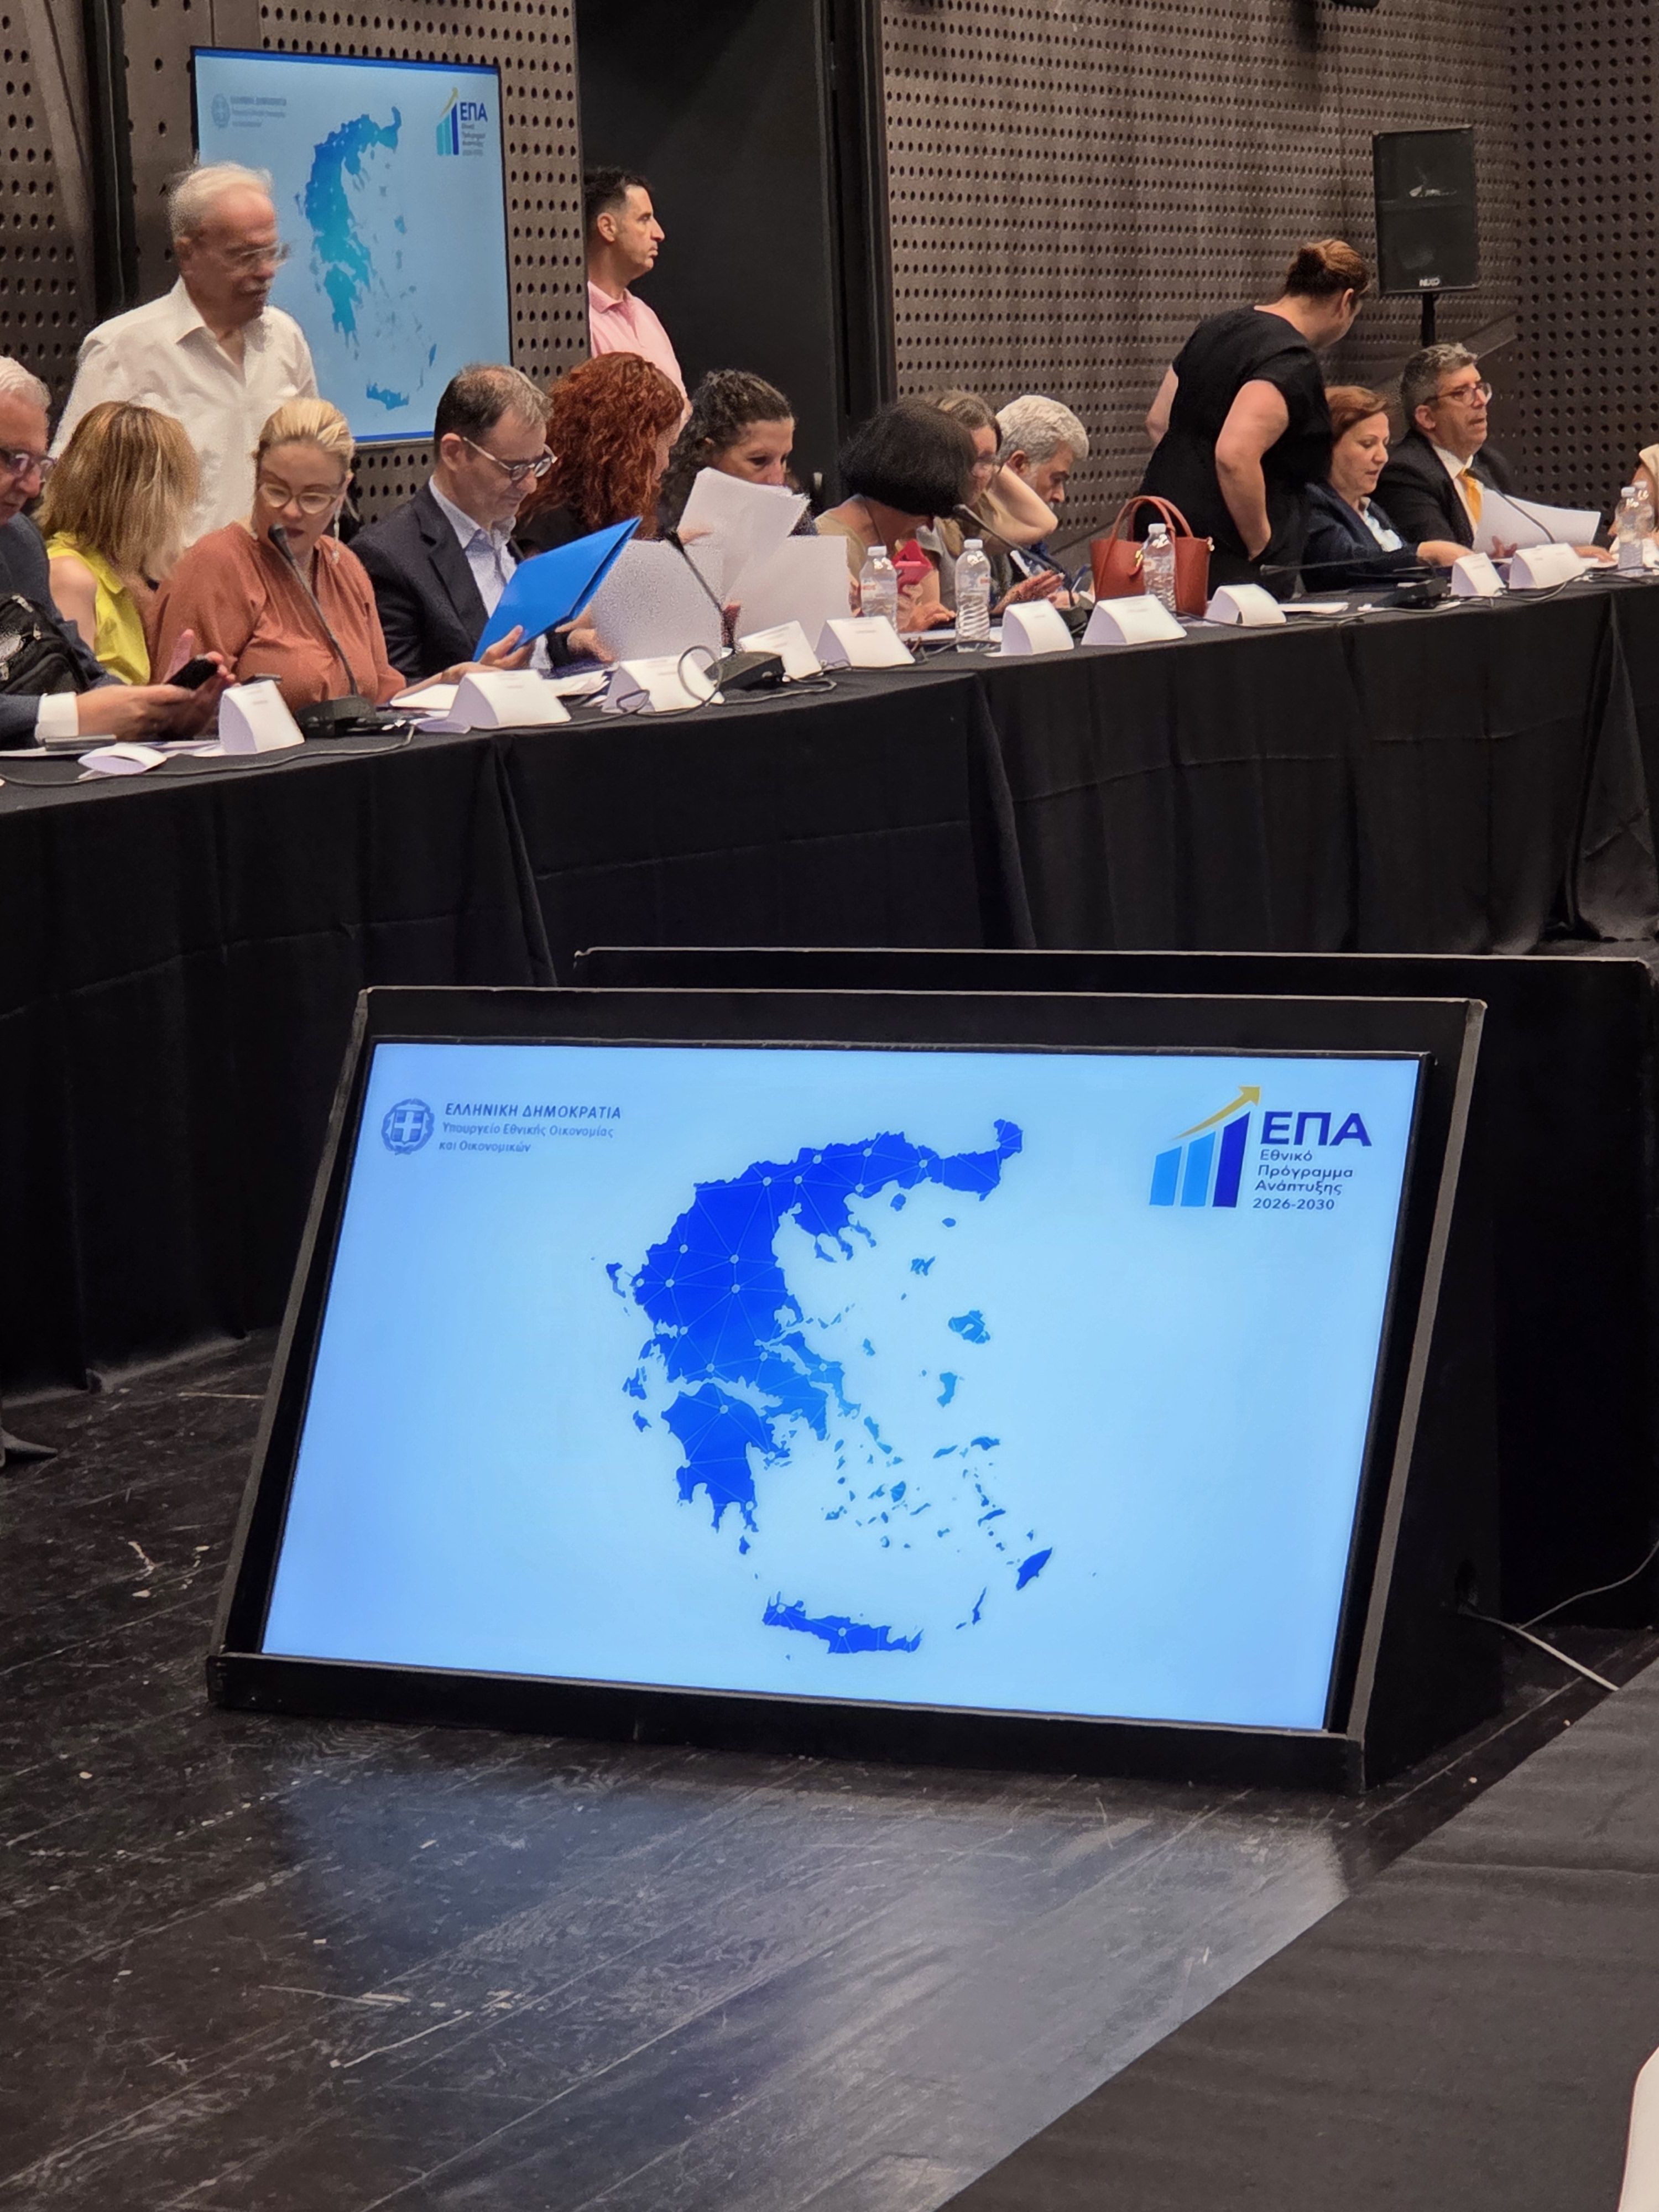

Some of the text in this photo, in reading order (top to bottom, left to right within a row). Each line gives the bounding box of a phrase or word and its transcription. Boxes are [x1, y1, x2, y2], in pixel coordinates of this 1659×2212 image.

[460, 102, 488, 122] ΕΠΑ
[445, 1102, 621, 1120] ΕΛΛΗΝΙΚΗ ΔΗΜΟΚΡΑΤΙΑ
[442, 1121, 614, 1139] Υπουργείο Εθνικής Οικονομίας
[1260, 1110, 1373, 1147] ΕΠΑ
[439, 1140, 531, 1154] και Οικονομικών
[1260, 1149, 1313, 1162] Εθνικό
[1257, 1164, 1354, 1181] Πρόγραμμα
[1254, 1180, 1343, 1196] Ανάπτυξης
[1252, 1198, 1335, 1210] 2026-2030
